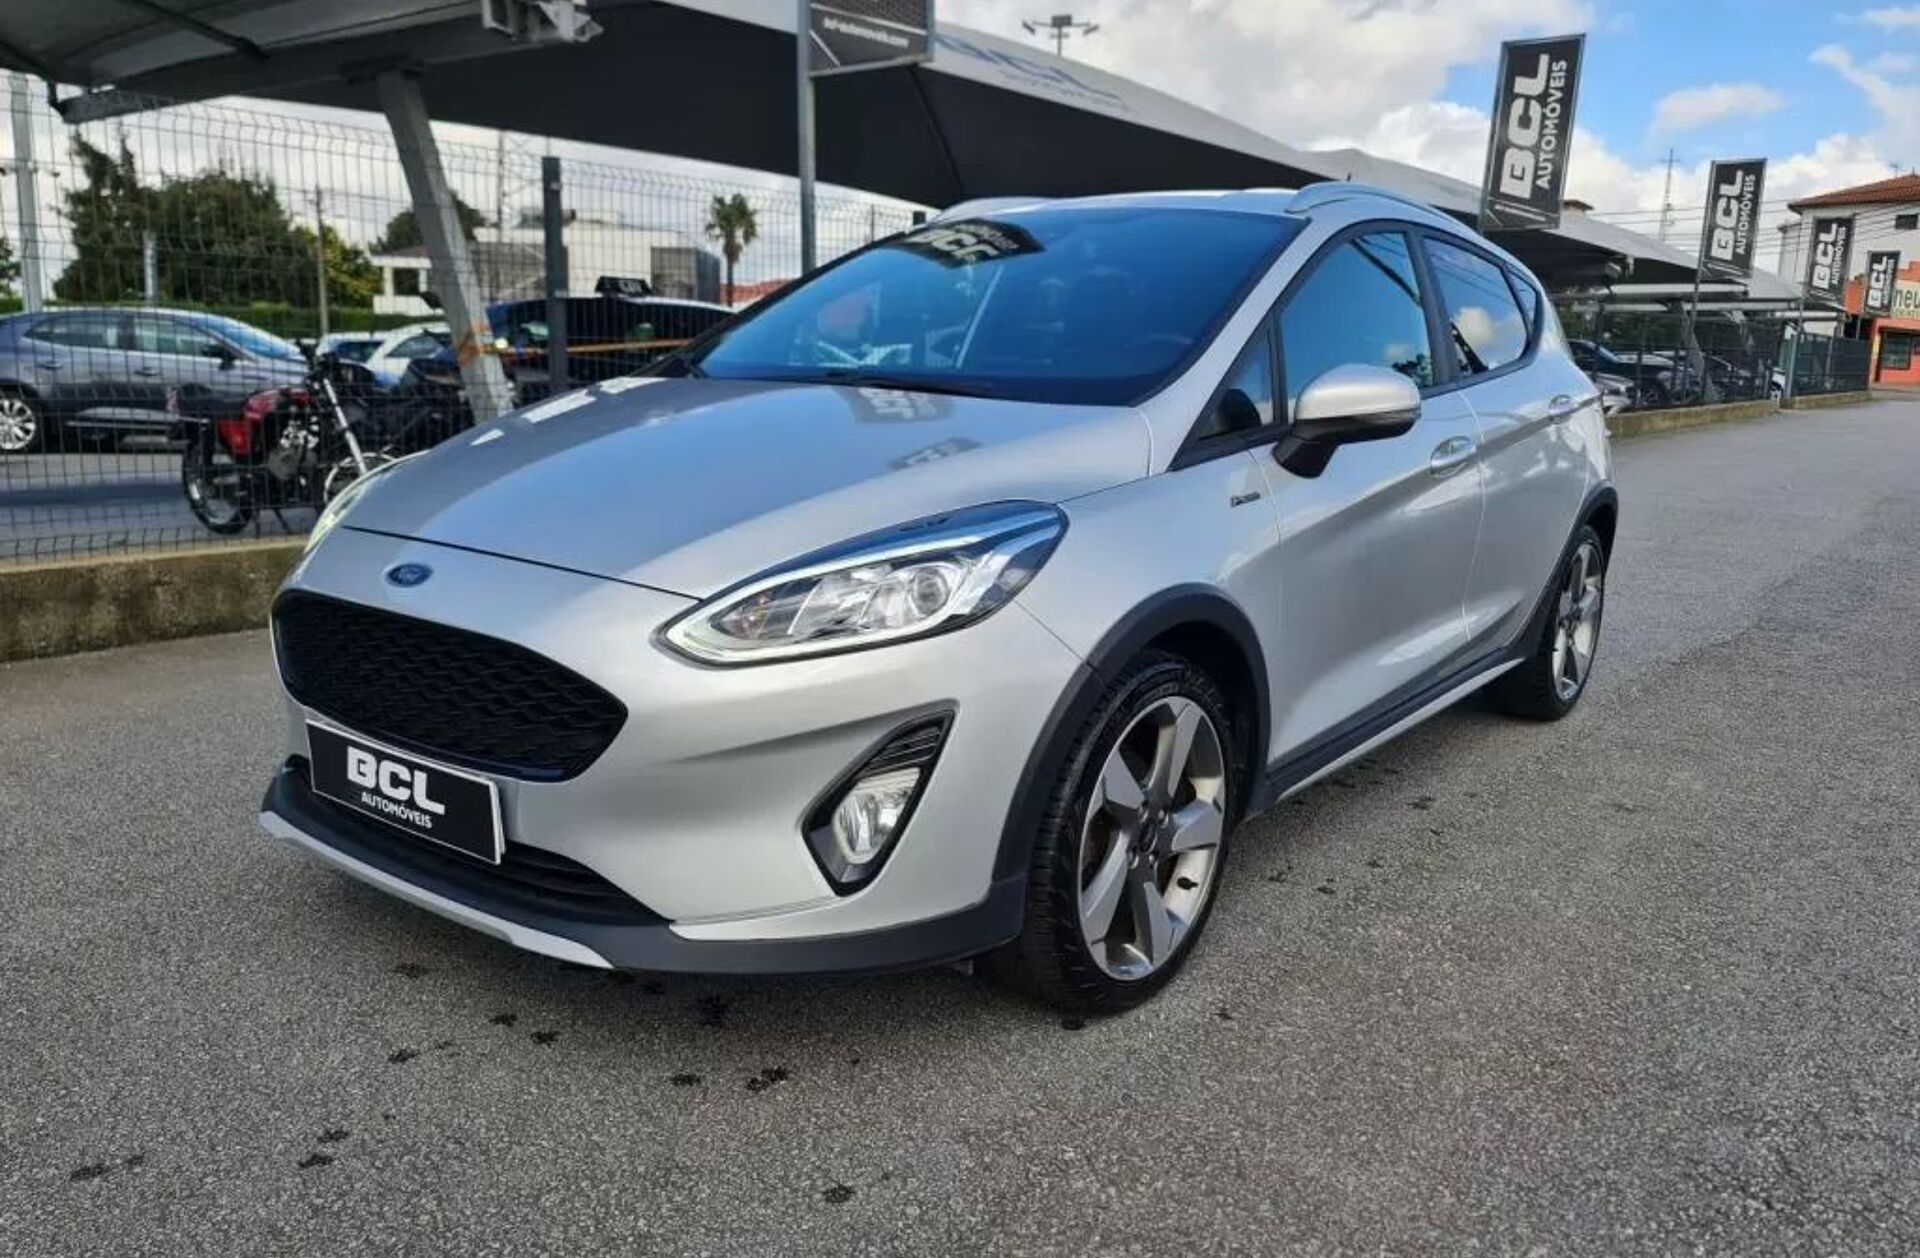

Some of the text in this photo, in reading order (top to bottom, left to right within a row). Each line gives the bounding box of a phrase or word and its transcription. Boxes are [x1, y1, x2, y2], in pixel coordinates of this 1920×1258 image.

[1501, 54, 1549, 199] BCL
[1534, 60, 1568, 190] AUTOMÓVEIS
[1711, 170, 1744, 261] BCL
[1734, 174, 1756, 255] AUTOMÓVEIS
[1812, 223, 1838, 290] BCL
[347, 746, 446, 816] BCL
[361, 790, 433, 830] AUTOMÓVEIS
